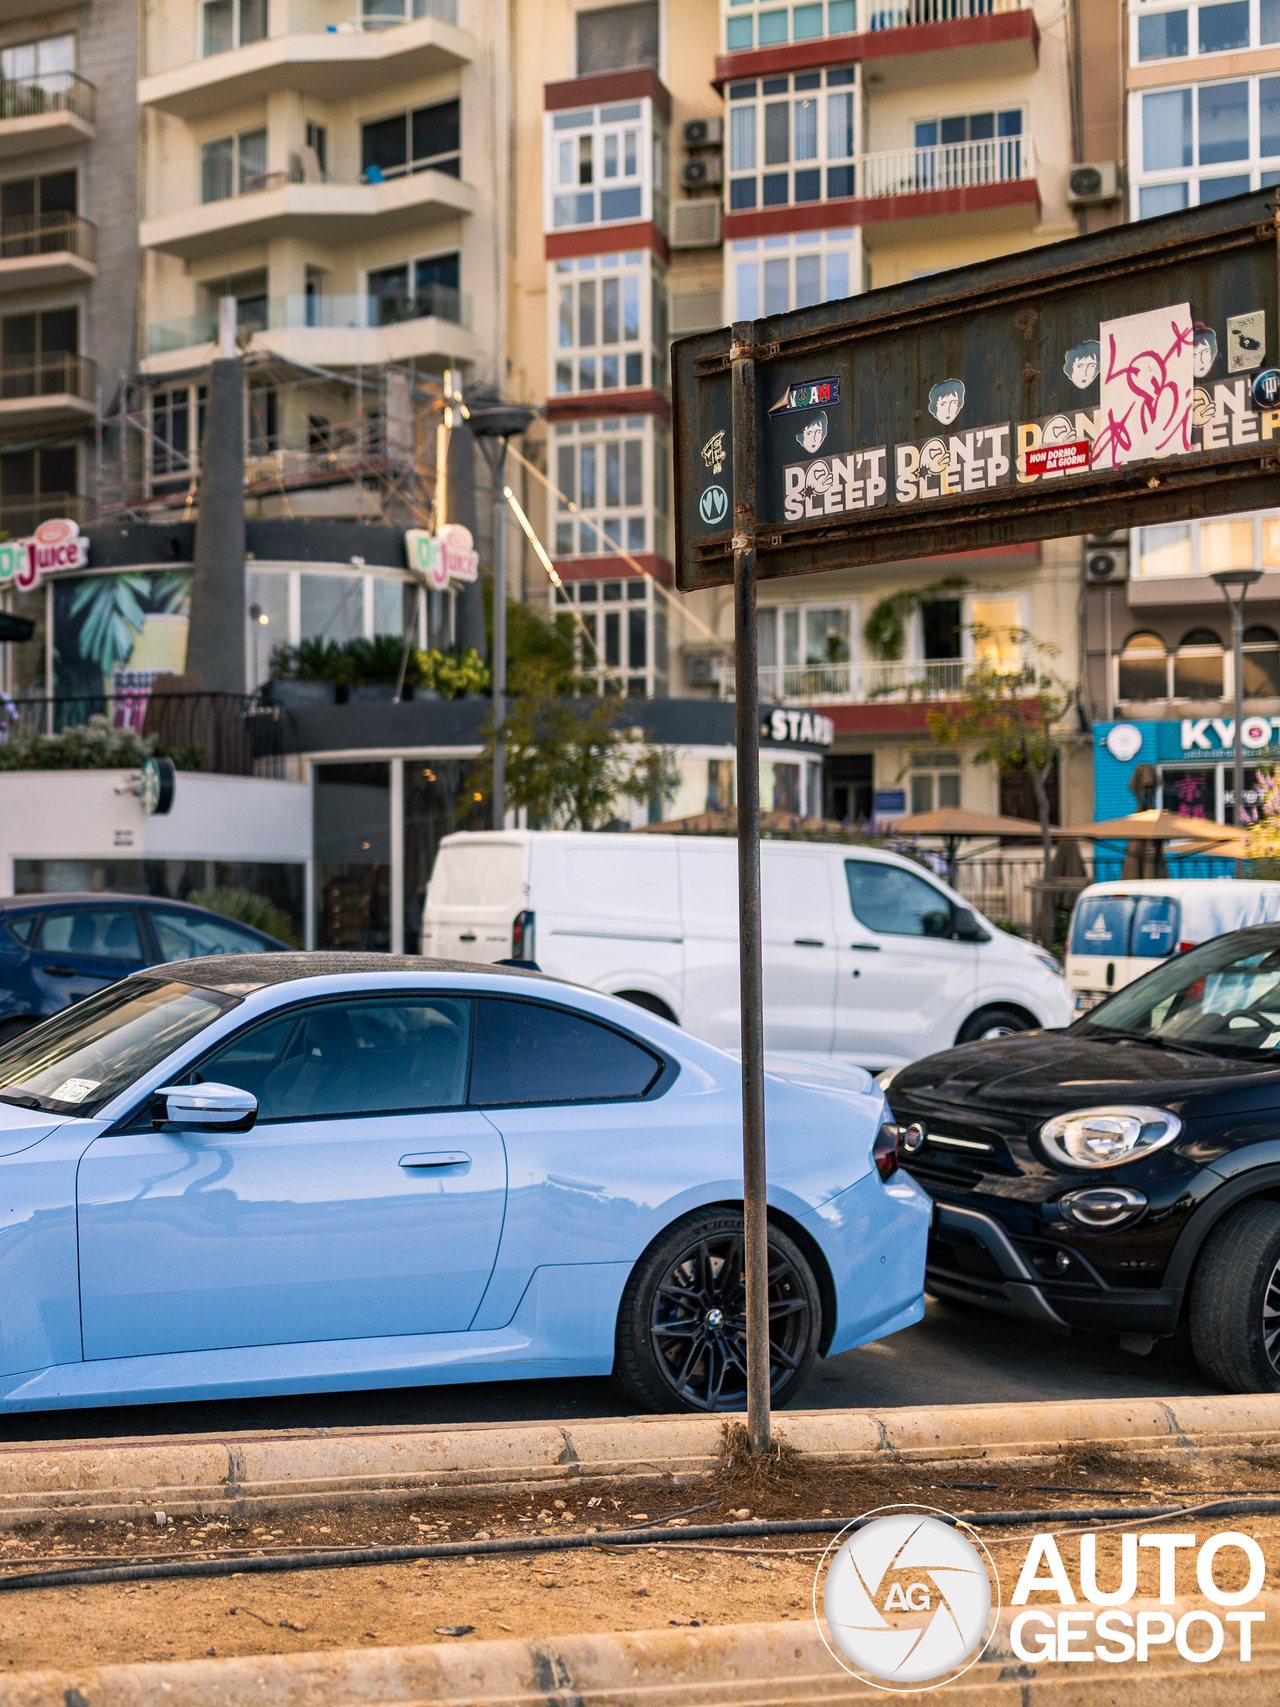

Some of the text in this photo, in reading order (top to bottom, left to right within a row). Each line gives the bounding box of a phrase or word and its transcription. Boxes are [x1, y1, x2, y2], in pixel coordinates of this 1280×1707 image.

[785, 449, 886, 495] DON'T
[897, 426, 1010, 477] DON'T
[1029, 446, 1077, 464] NON DORMO
[1046, 454, 1086, 469] DA GIORNI
[784, 477, 886, 521] SLEEP
[896, 456, 1010, 502] SLEEP
